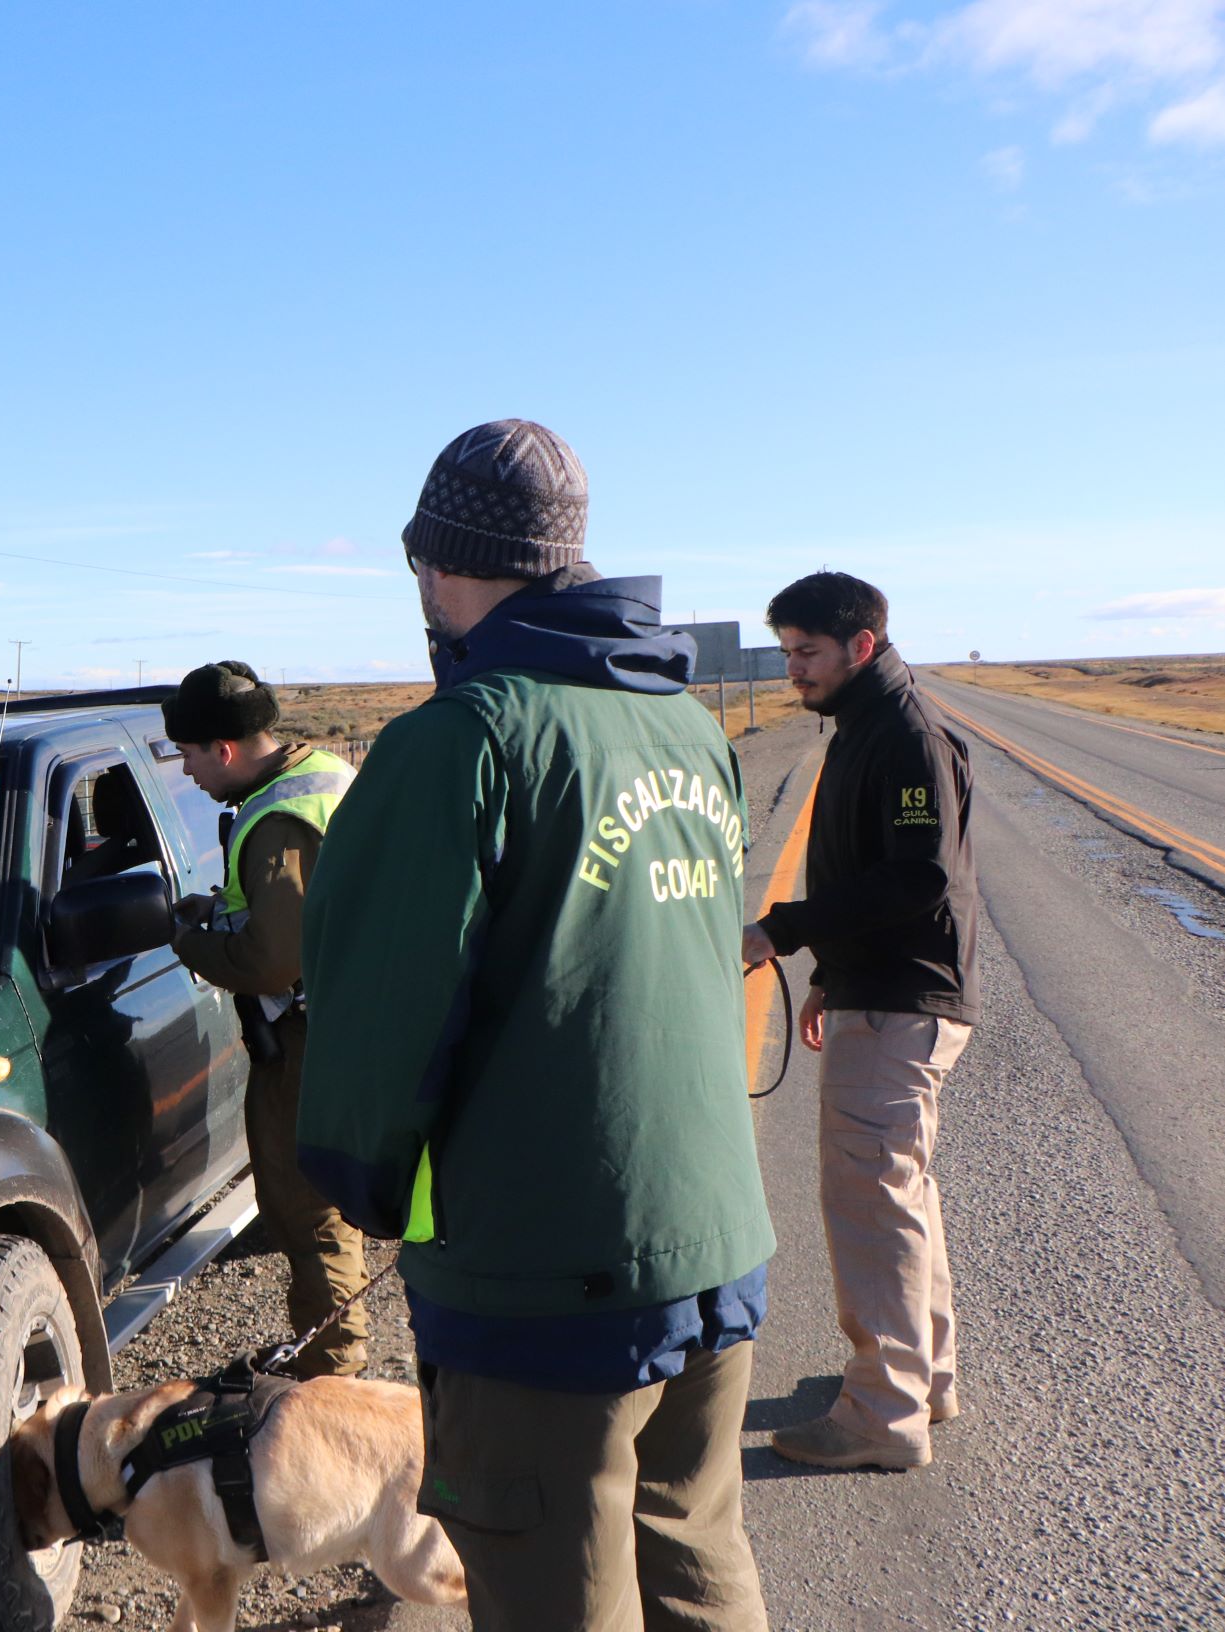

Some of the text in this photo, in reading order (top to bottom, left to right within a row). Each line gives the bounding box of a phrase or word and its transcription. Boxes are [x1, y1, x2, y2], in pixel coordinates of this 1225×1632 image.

[901, 787, 927, 808] K9
[894, 817, 938, 826] CANINO
[161, 1418, 203, 1450] PDI
